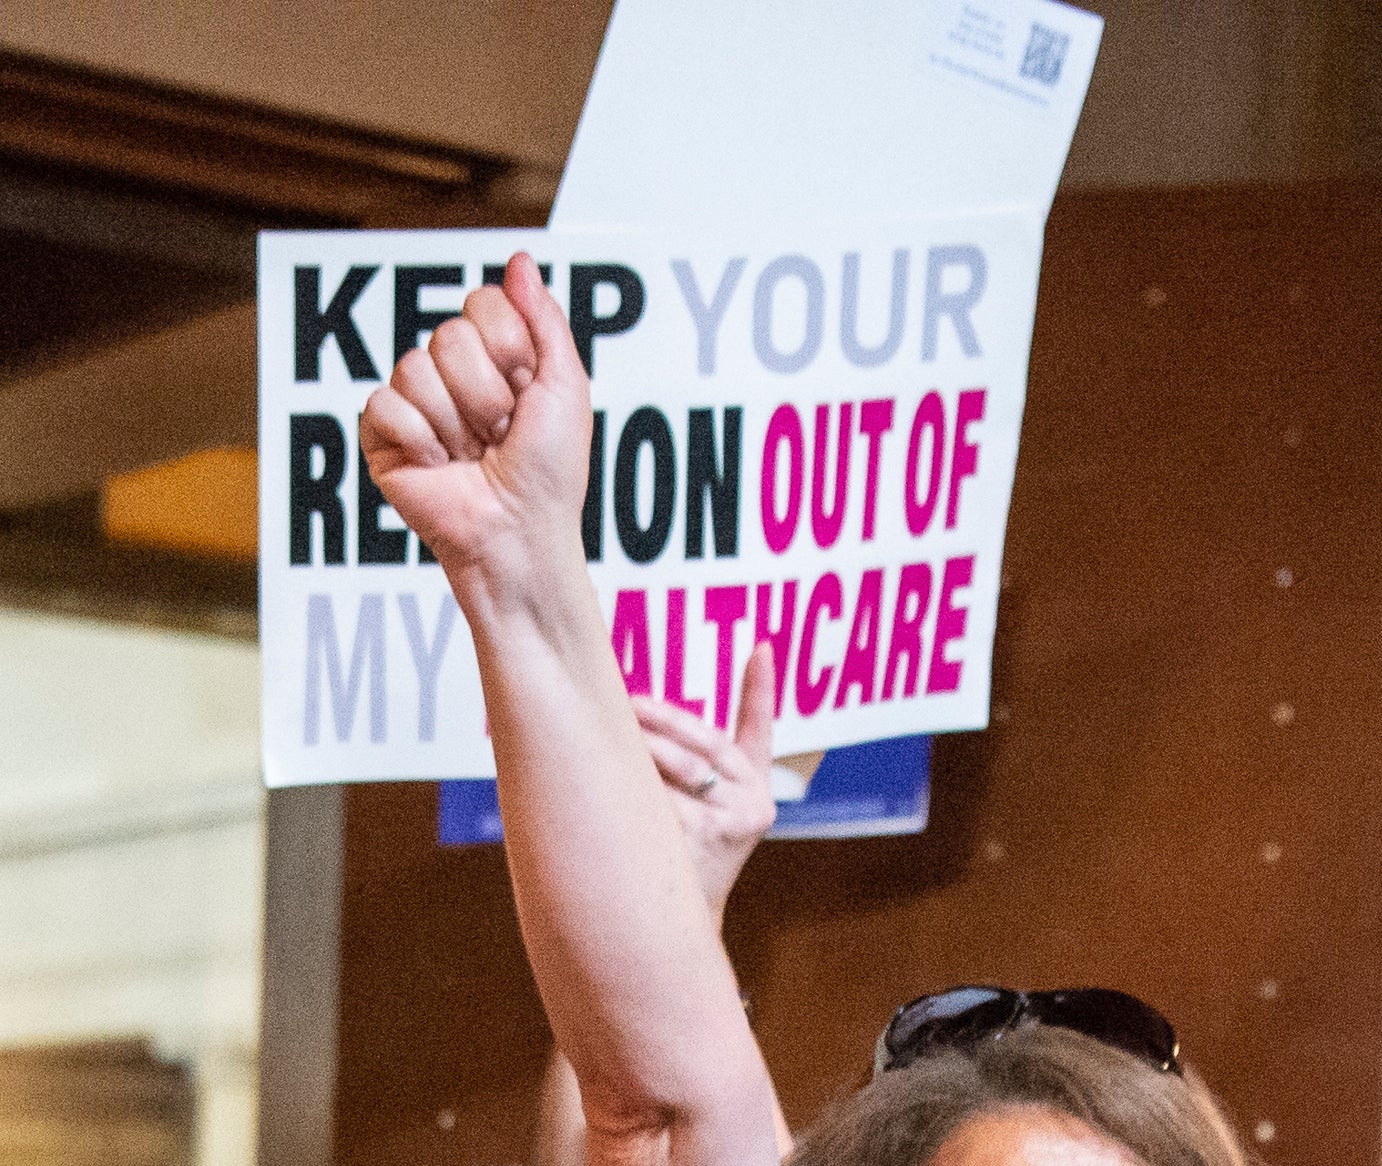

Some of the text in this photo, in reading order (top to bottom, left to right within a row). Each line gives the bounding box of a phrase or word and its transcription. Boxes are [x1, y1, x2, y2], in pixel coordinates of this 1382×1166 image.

[670, 243, 990, 377] YOUR
[760, 396, 895, 554] OUT
[903, 387, 988, 538] OF
[302, 592, 455, 747] MY
